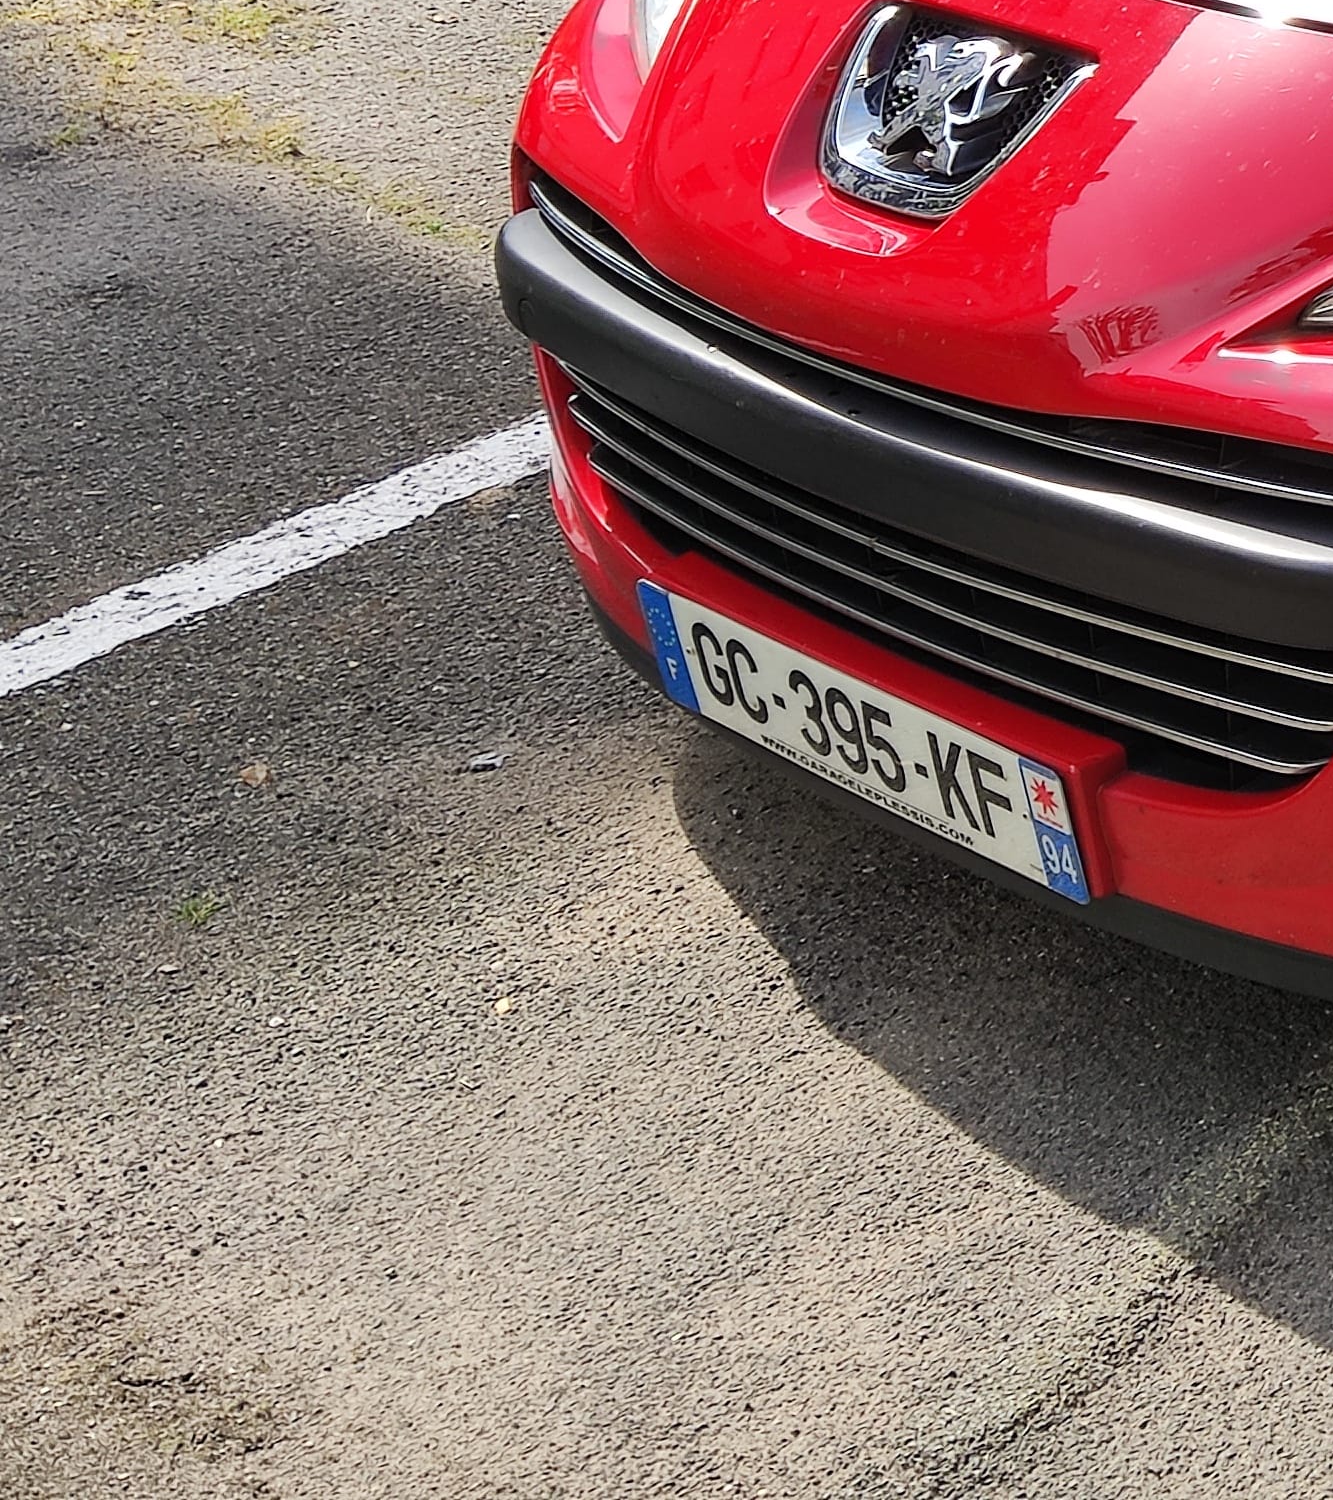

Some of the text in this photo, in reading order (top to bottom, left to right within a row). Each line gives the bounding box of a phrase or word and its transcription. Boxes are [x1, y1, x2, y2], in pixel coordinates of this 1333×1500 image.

[665, 655, 680, 681] F
[691, 621, 1013, 840] GC-395-KF
[1041, 834, 1078, 884] 94
